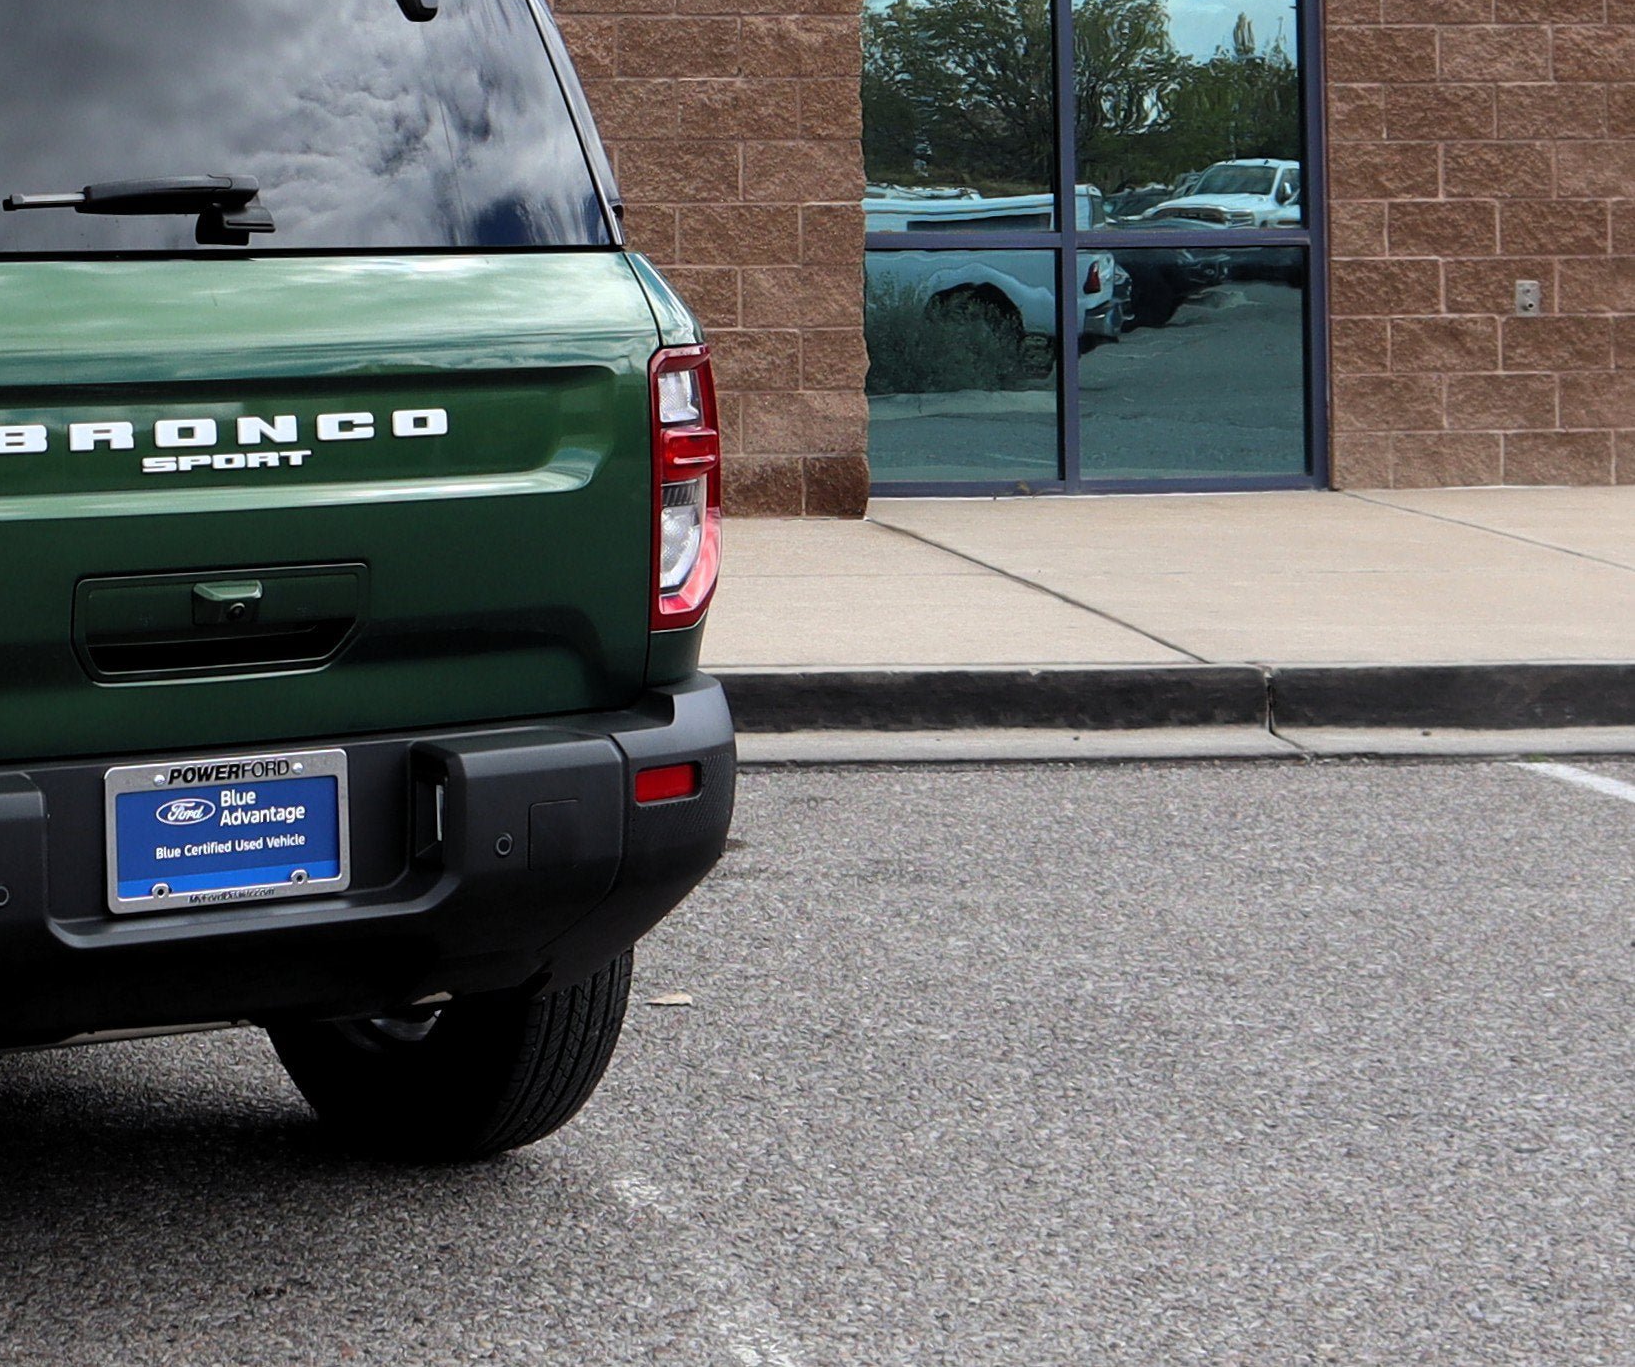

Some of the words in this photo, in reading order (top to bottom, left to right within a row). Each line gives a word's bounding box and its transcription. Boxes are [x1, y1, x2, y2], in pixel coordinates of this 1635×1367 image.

[141, 449, 313, 473] SPORT
[219, 789, 257, 808] Blue
[166, 801, 206, 822] Ford
[219, 805, 306, 827] Advantage
[155, 847, 182, 860] Blue
[184, 841, 233, 856] Certified
[235, 836, 264, 851] Used
[266, 833, 306, 849] Vehicle
